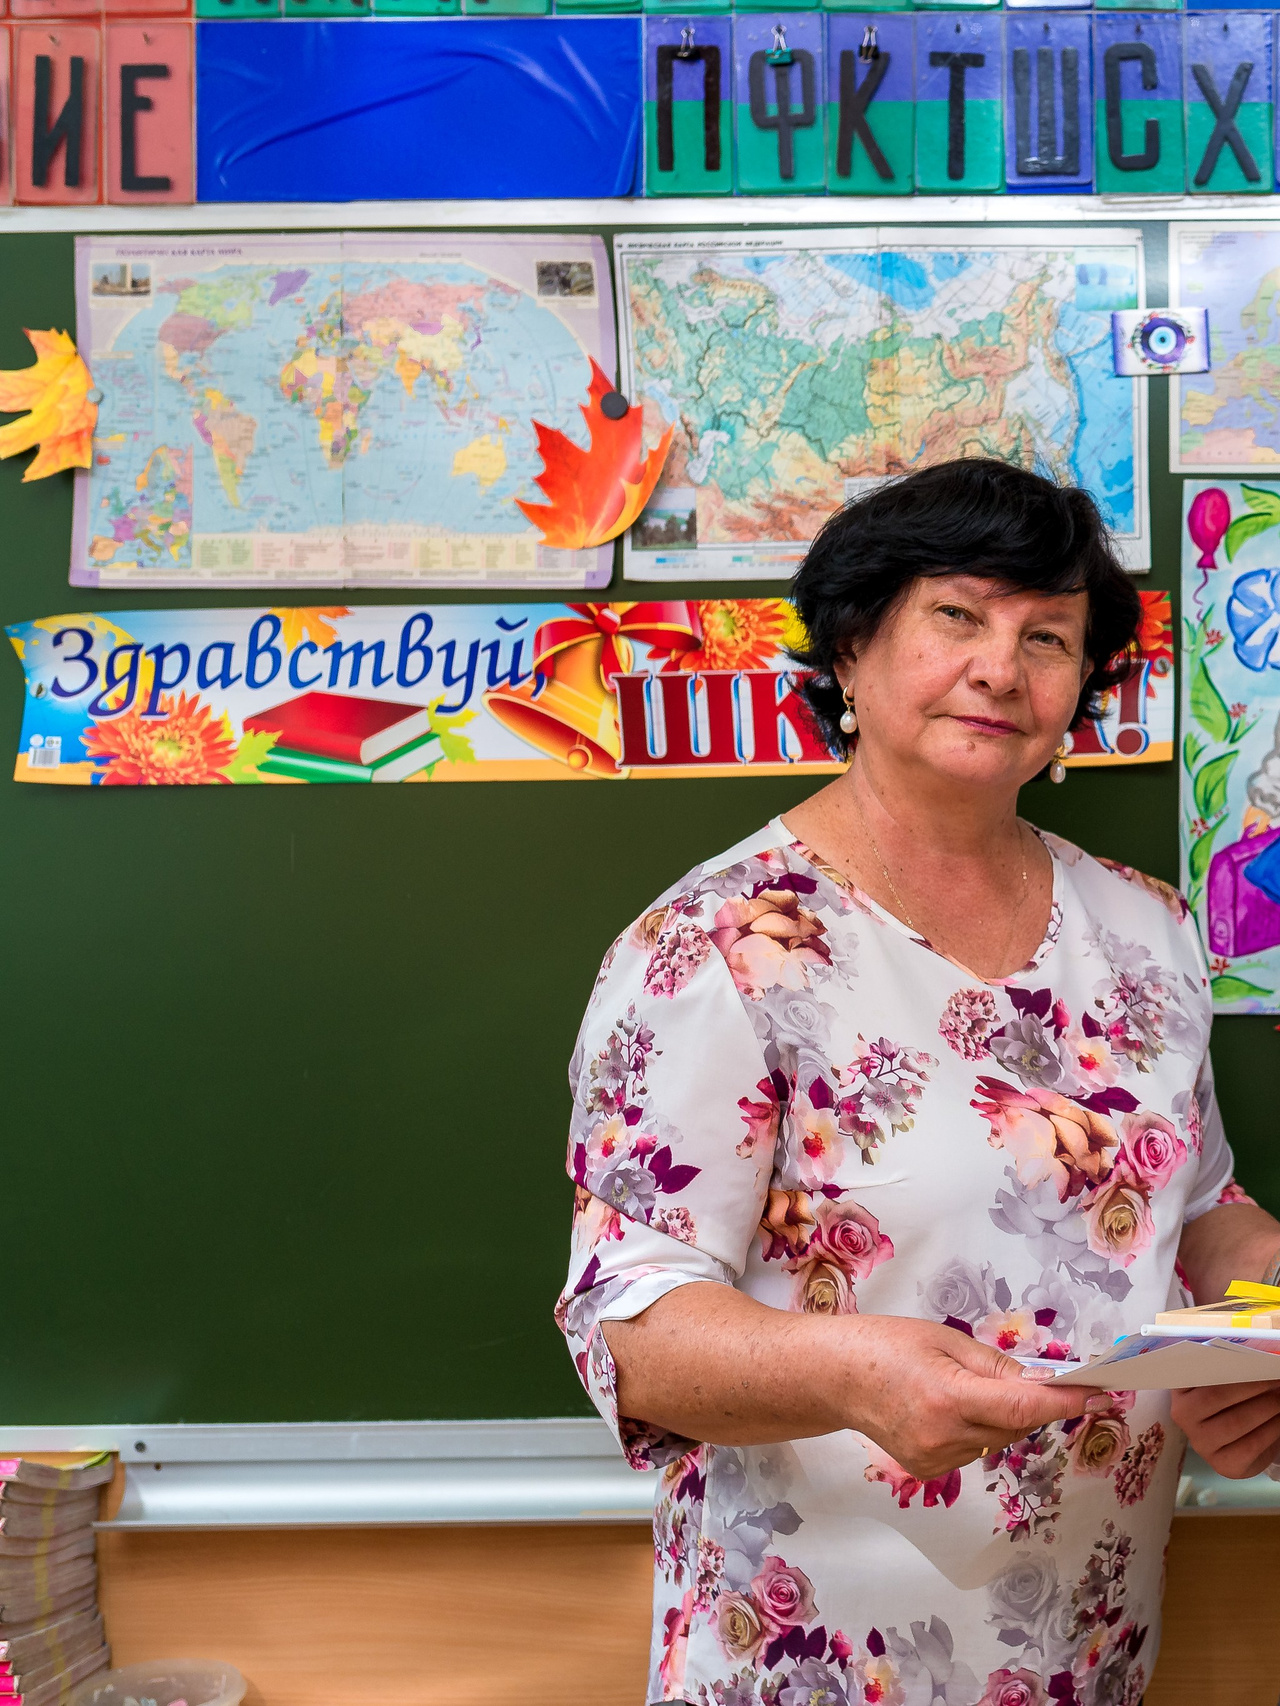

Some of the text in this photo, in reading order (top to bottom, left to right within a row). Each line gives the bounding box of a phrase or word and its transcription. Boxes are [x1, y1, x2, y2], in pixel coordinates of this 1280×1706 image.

[32, 55, 171, 191] И Е
[656, 45, 720, 172] П
[749, 49, 816, 180] Ф
[836, 49, 896, 178] К
[928, 51, 986, 180] Т
[1012, 46, 1080, 175] Ш
[1104, 41, 1159, 170] С
[1191, 62, 1261, 186] Х
[50, 611, 549, 720] Здравствуй,
